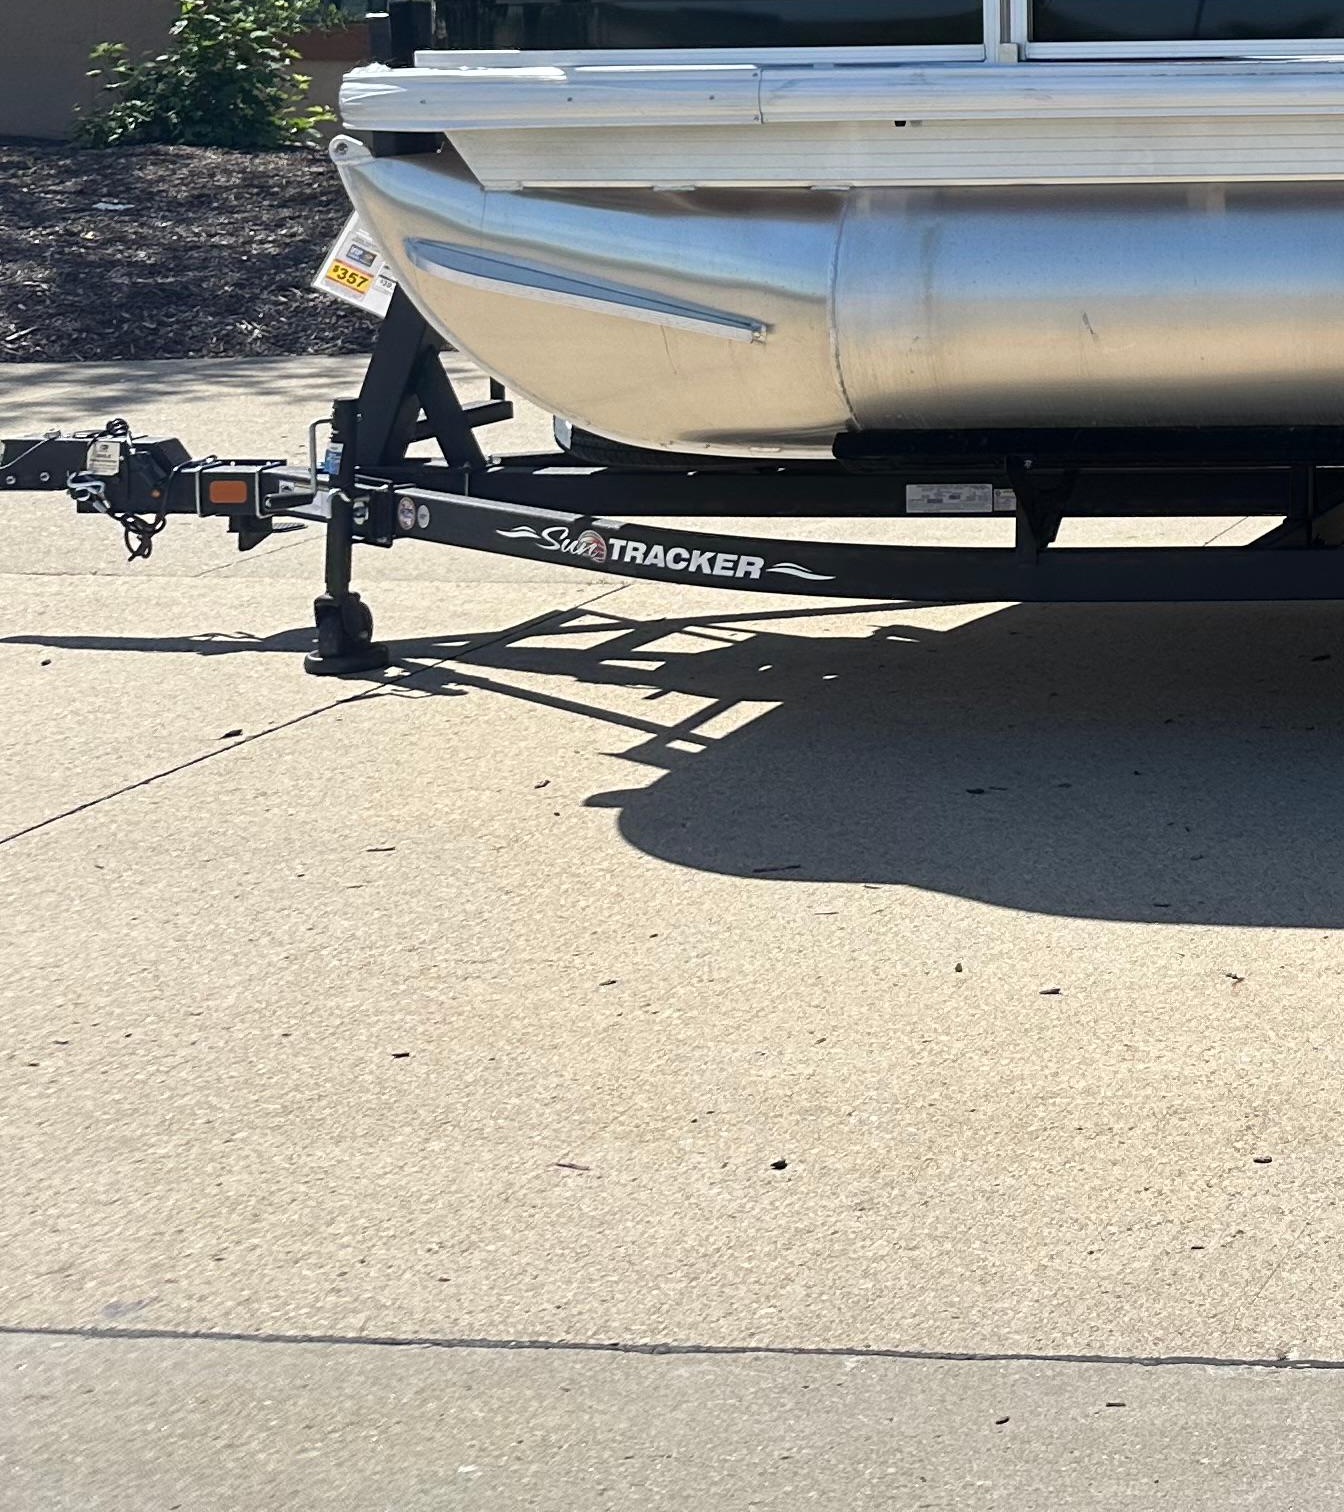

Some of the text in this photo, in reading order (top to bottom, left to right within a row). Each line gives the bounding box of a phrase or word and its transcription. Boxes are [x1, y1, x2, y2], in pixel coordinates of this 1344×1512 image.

[332, 264, 369, 289] $357
[534, 525, 765, 580] Sun TRACKER
